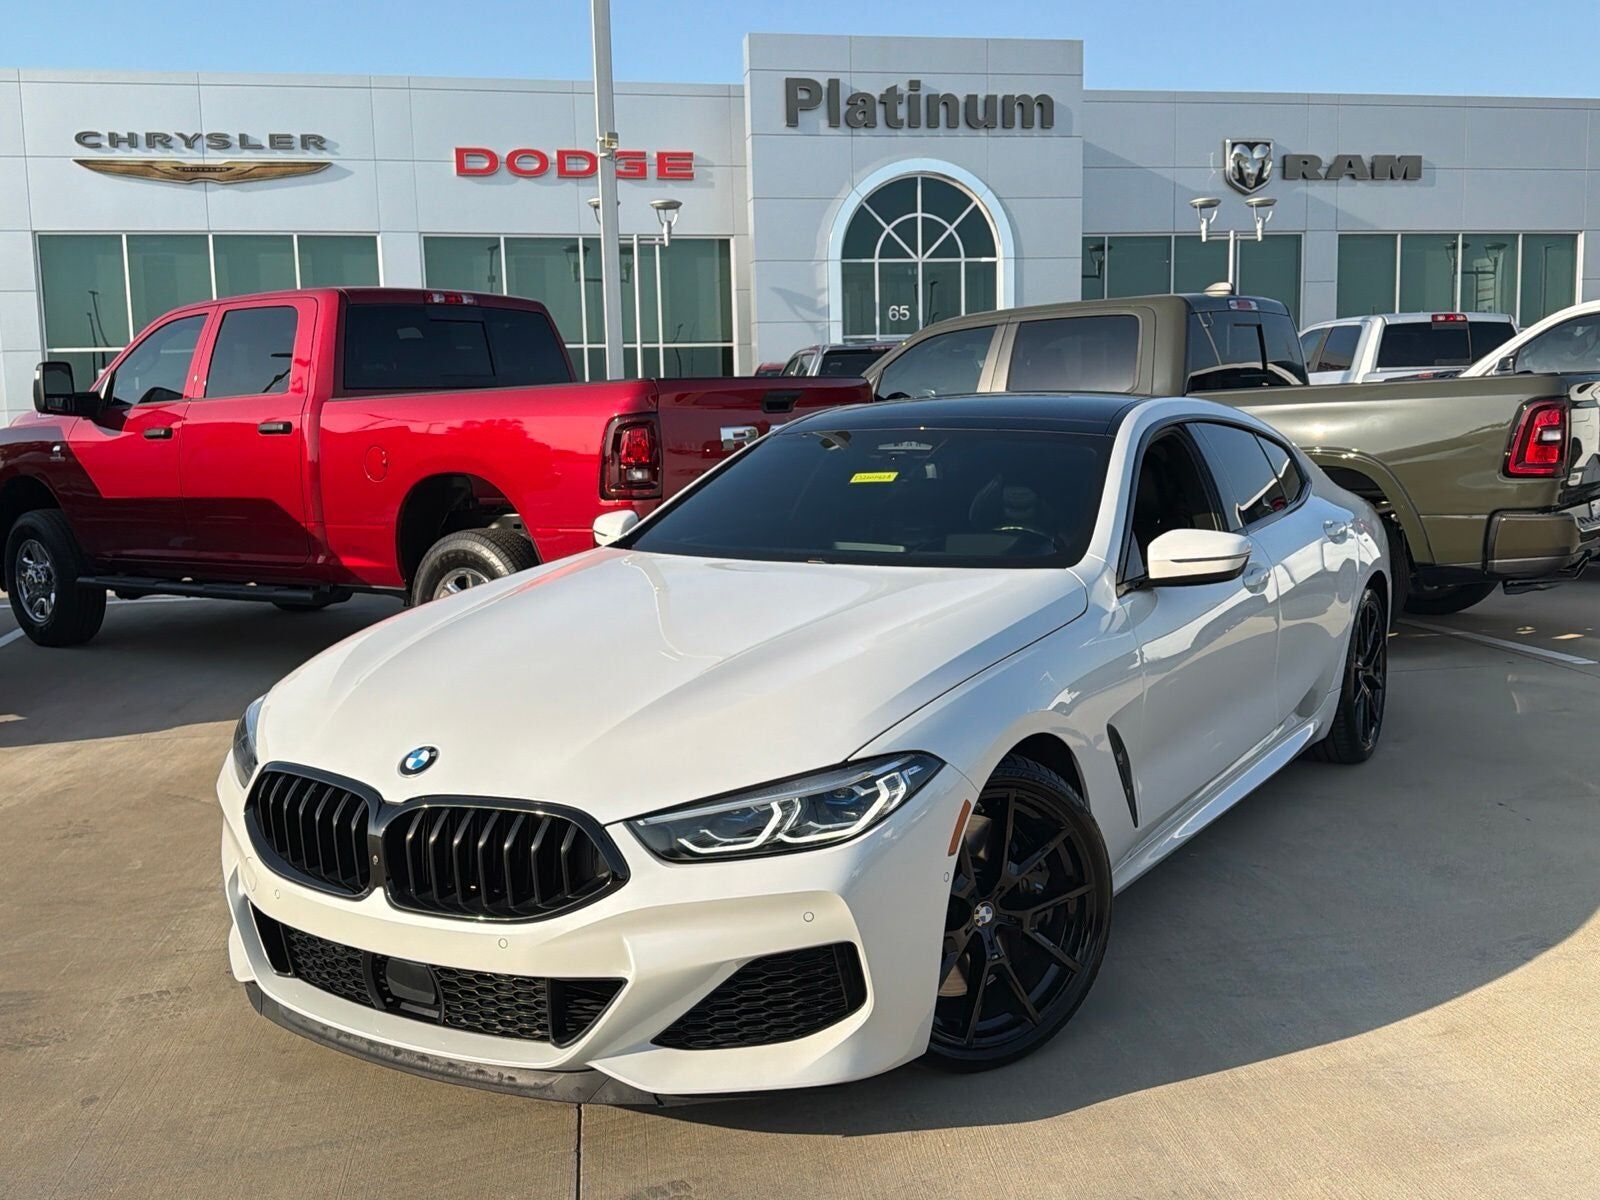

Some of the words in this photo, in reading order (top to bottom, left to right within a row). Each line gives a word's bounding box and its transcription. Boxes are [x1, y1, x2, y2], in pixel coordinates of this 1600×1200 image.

[785, 77, 1054, 129] Platinum
[74, 131, 327, 150] CHRYSLER
[454, 147, 694, 180] DODGE
[1283, 154, 1423, 181] RAM
[888, 305, 910, 321] 65
